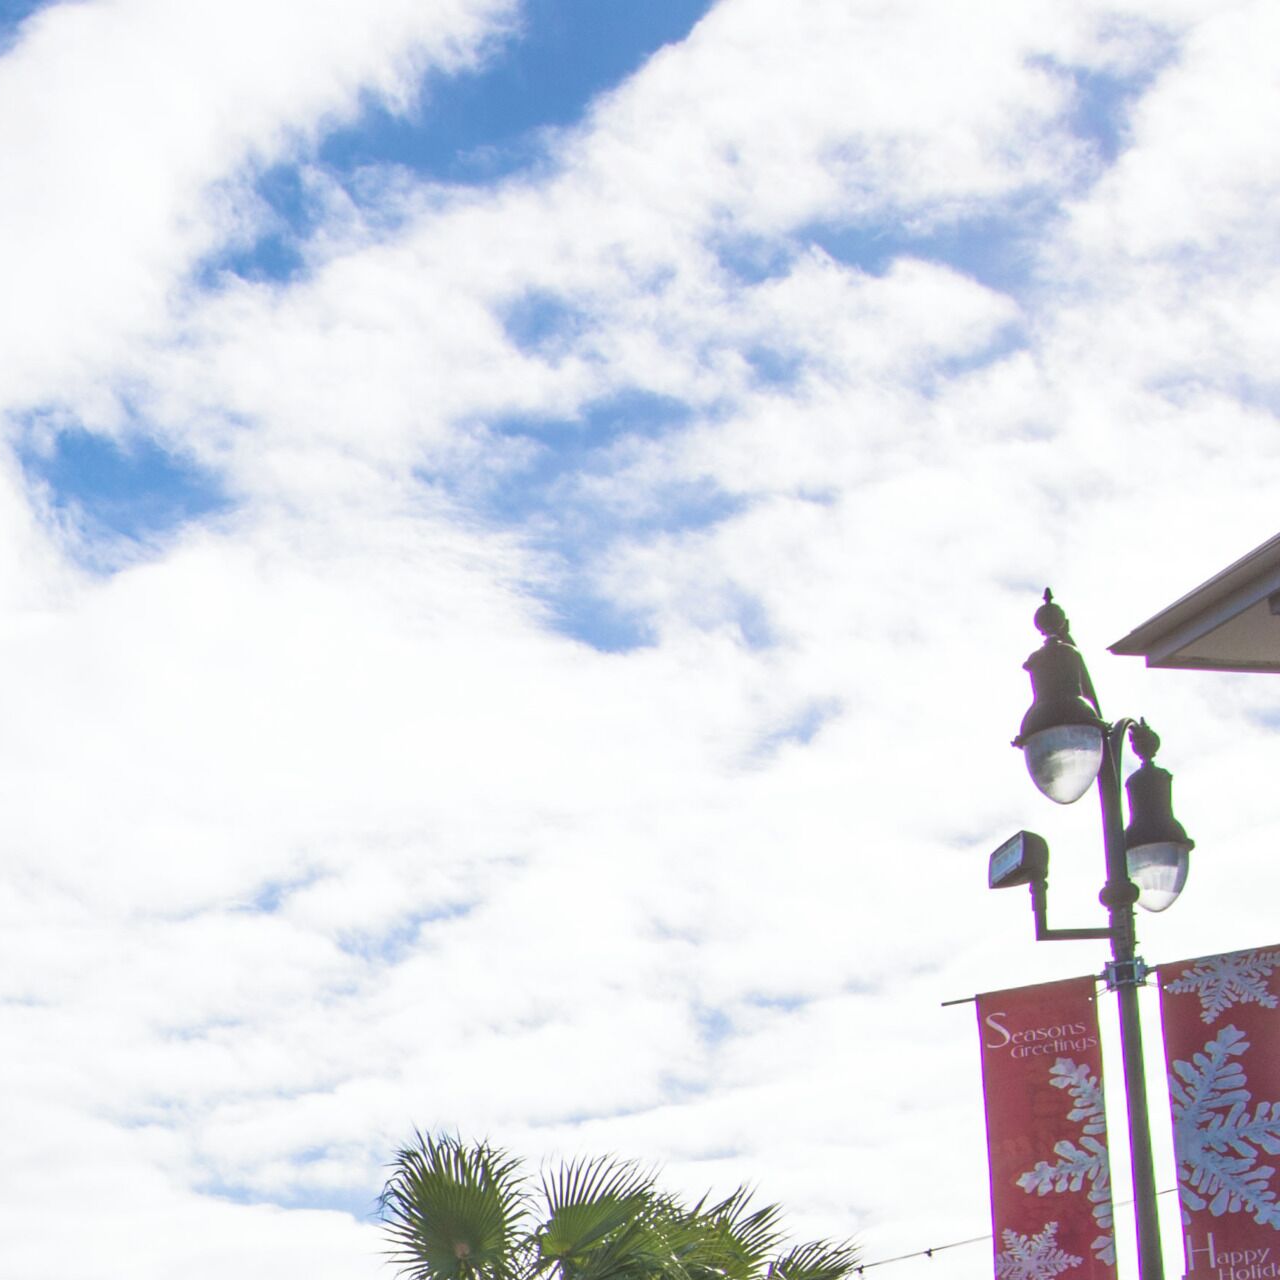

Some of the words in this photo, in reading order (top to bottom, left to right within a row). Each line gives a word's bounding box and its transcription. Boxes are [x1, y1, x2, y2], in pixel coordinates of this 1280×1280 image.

[985, 1012, 1087, 1049] Seasons
[1010, 1036, 1097, 1059] Greetings
[1186, 1231, 1271, 1271] Happy
